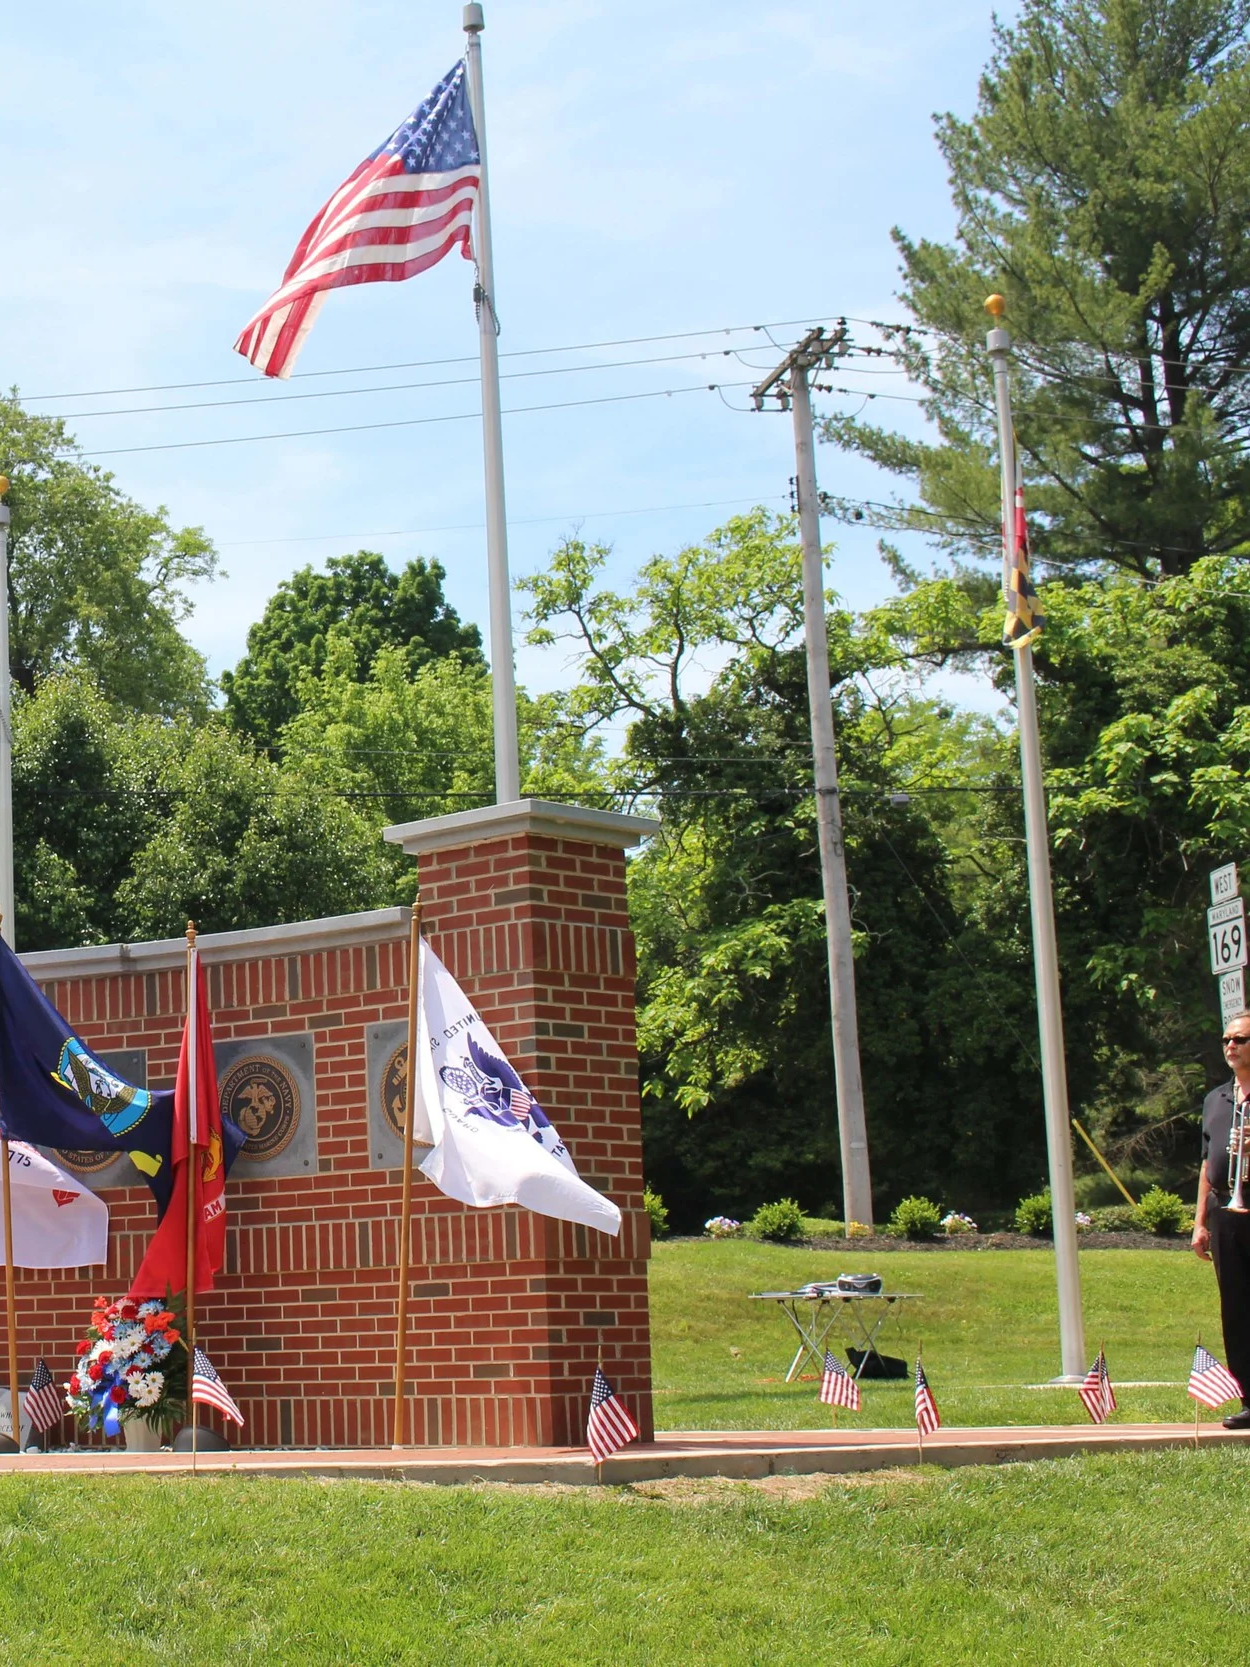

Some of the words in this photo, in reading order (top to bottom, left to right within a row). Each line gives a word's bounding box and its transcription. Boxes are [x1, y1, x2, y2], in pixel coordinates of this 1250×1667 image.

[1214, 872, 1232, 894] WEST
[1212, 904, 1239, 920] MARYLAND
[1213, 925, 1241, 966] 169
[1222, 977, 1241, 996] SNOW
[221, 1064, 261, 1113] DEPARTMENT
[279, 1080, 292, 1109] NAVY
[8, 1150, 32, 1167] 775
[0, 1411, 13, 1419] WH
